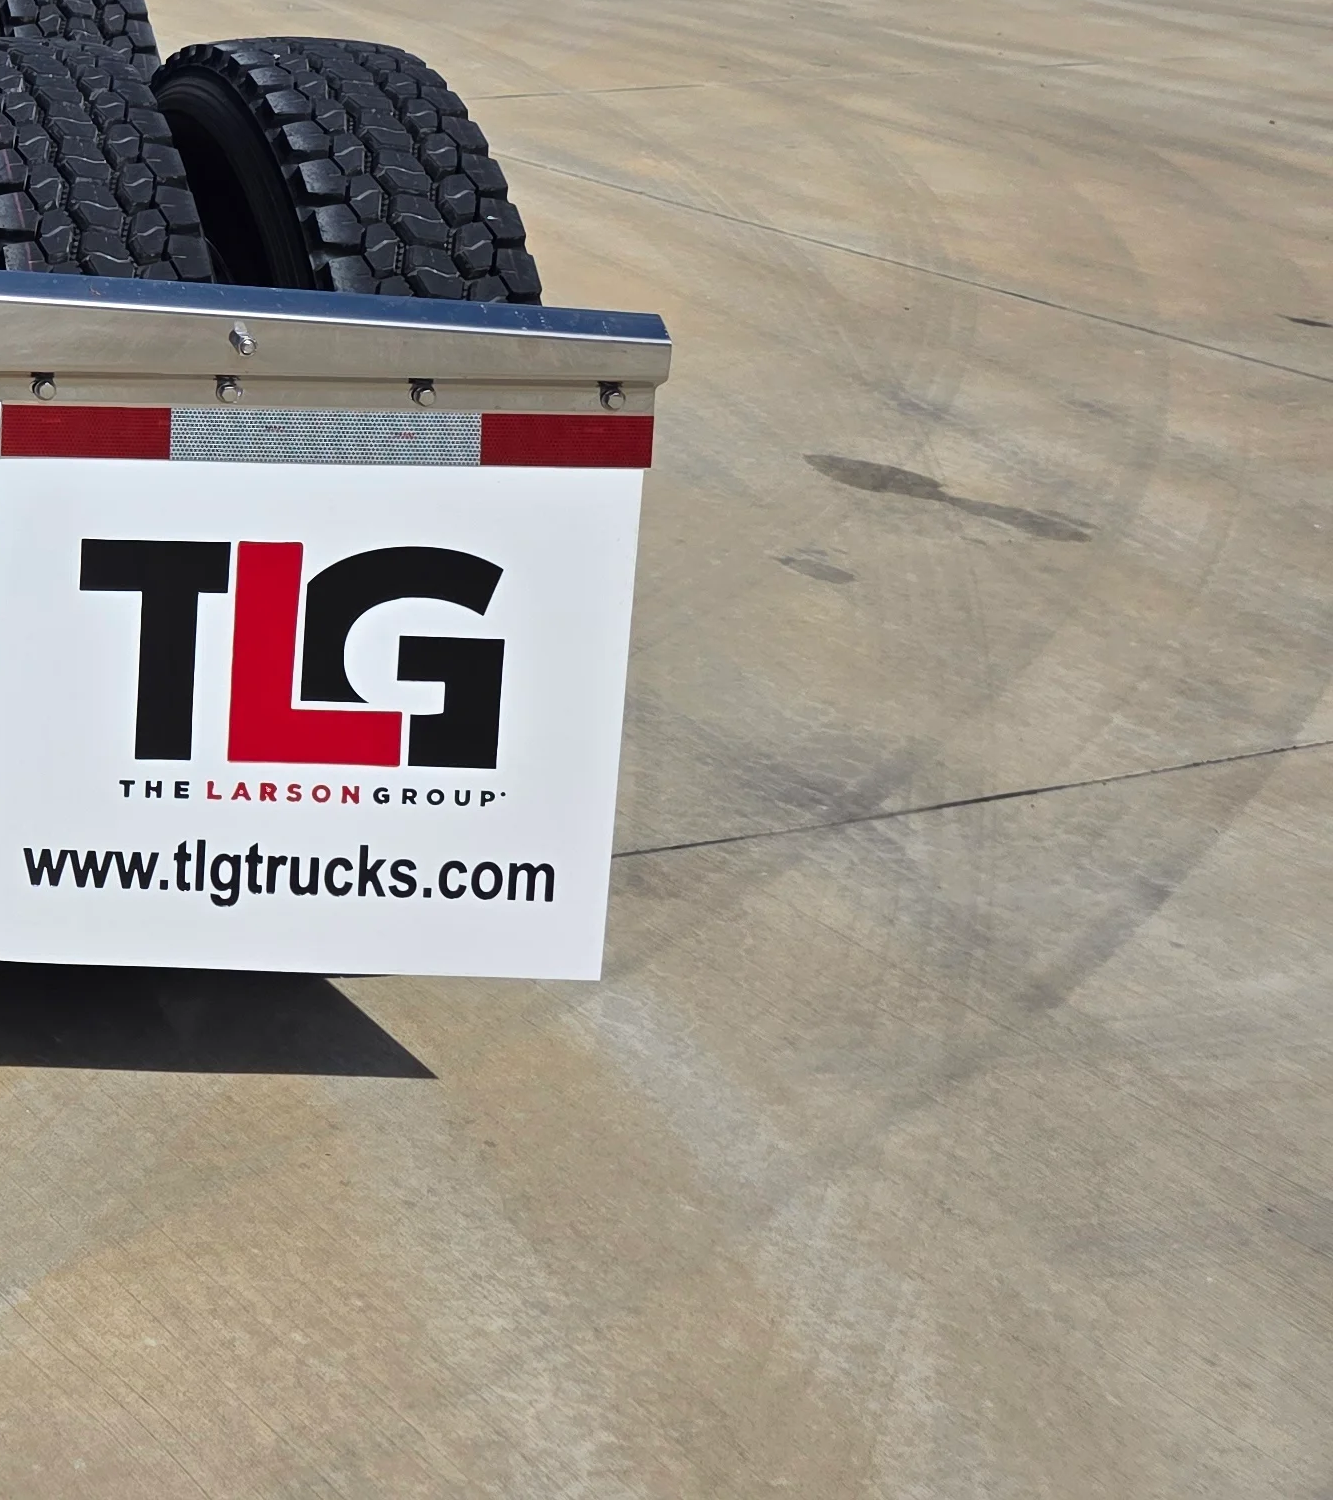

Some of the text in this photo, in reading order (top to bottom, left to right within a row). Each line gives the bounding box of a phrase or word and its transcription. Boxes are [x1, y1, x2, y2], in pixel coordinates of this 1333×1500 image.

[79, 538, 506, 770] TLG
[118, 779, 496, 807] THE LARSON GROUP
[23, 839, 555, 908] www.tlgtrucks.com
